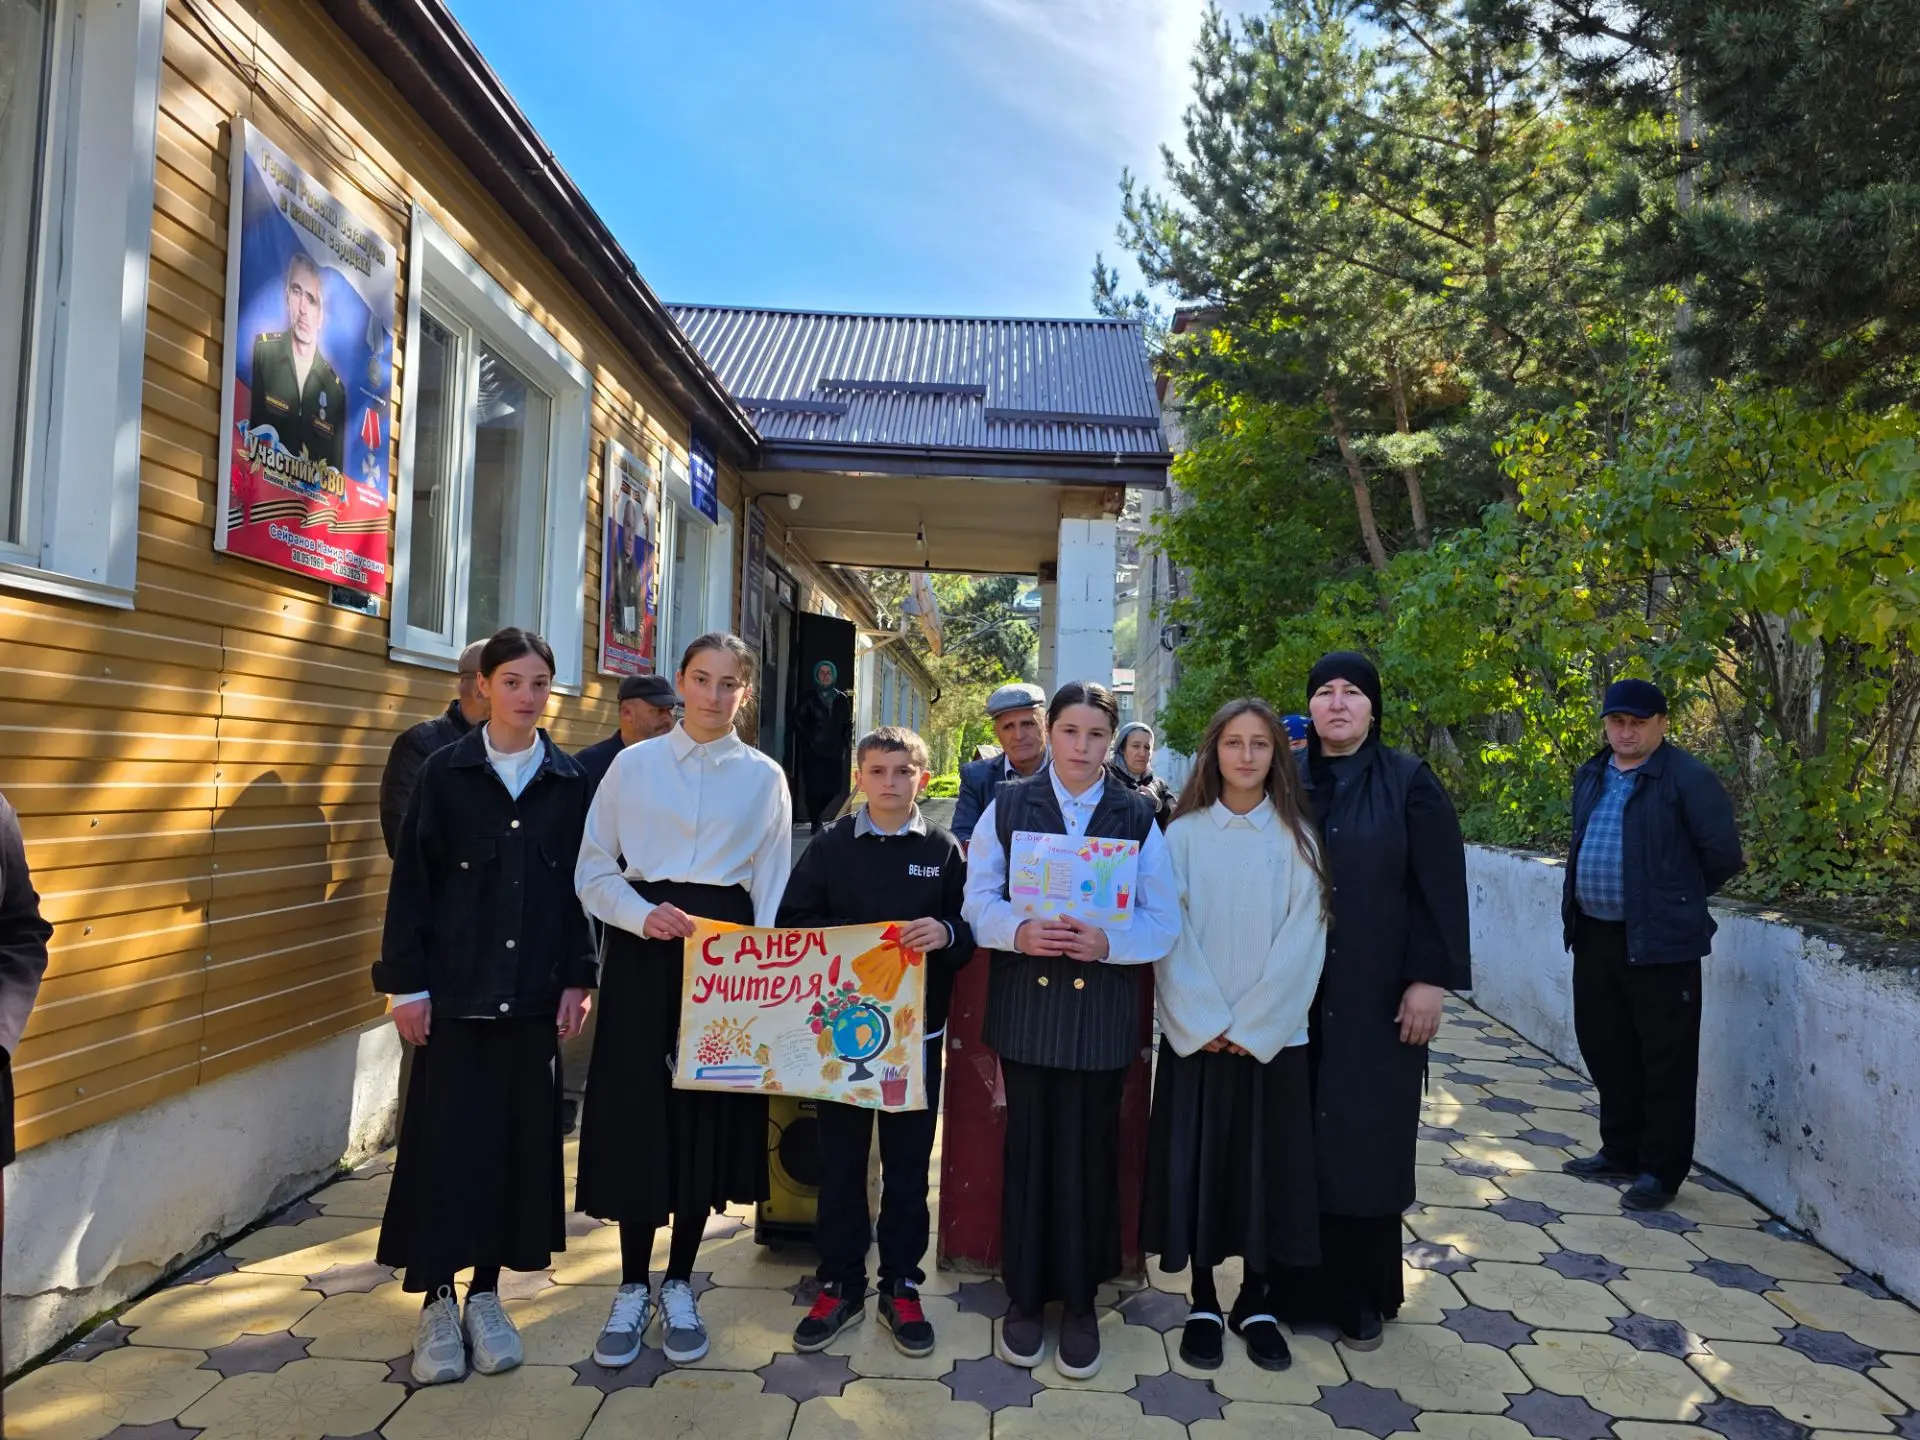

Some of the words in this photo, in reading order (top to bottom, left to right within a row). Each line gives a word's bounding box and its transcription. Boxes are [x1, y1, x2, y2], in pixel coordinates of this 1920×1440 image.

[299, 180, 338, 226] России
[248, 432, 318, 484] Участник
[319, 463, 346, 497] СВО
[269, 523, 315, 551] Сейранов
[344, 549, 385, 575] Юнусович
